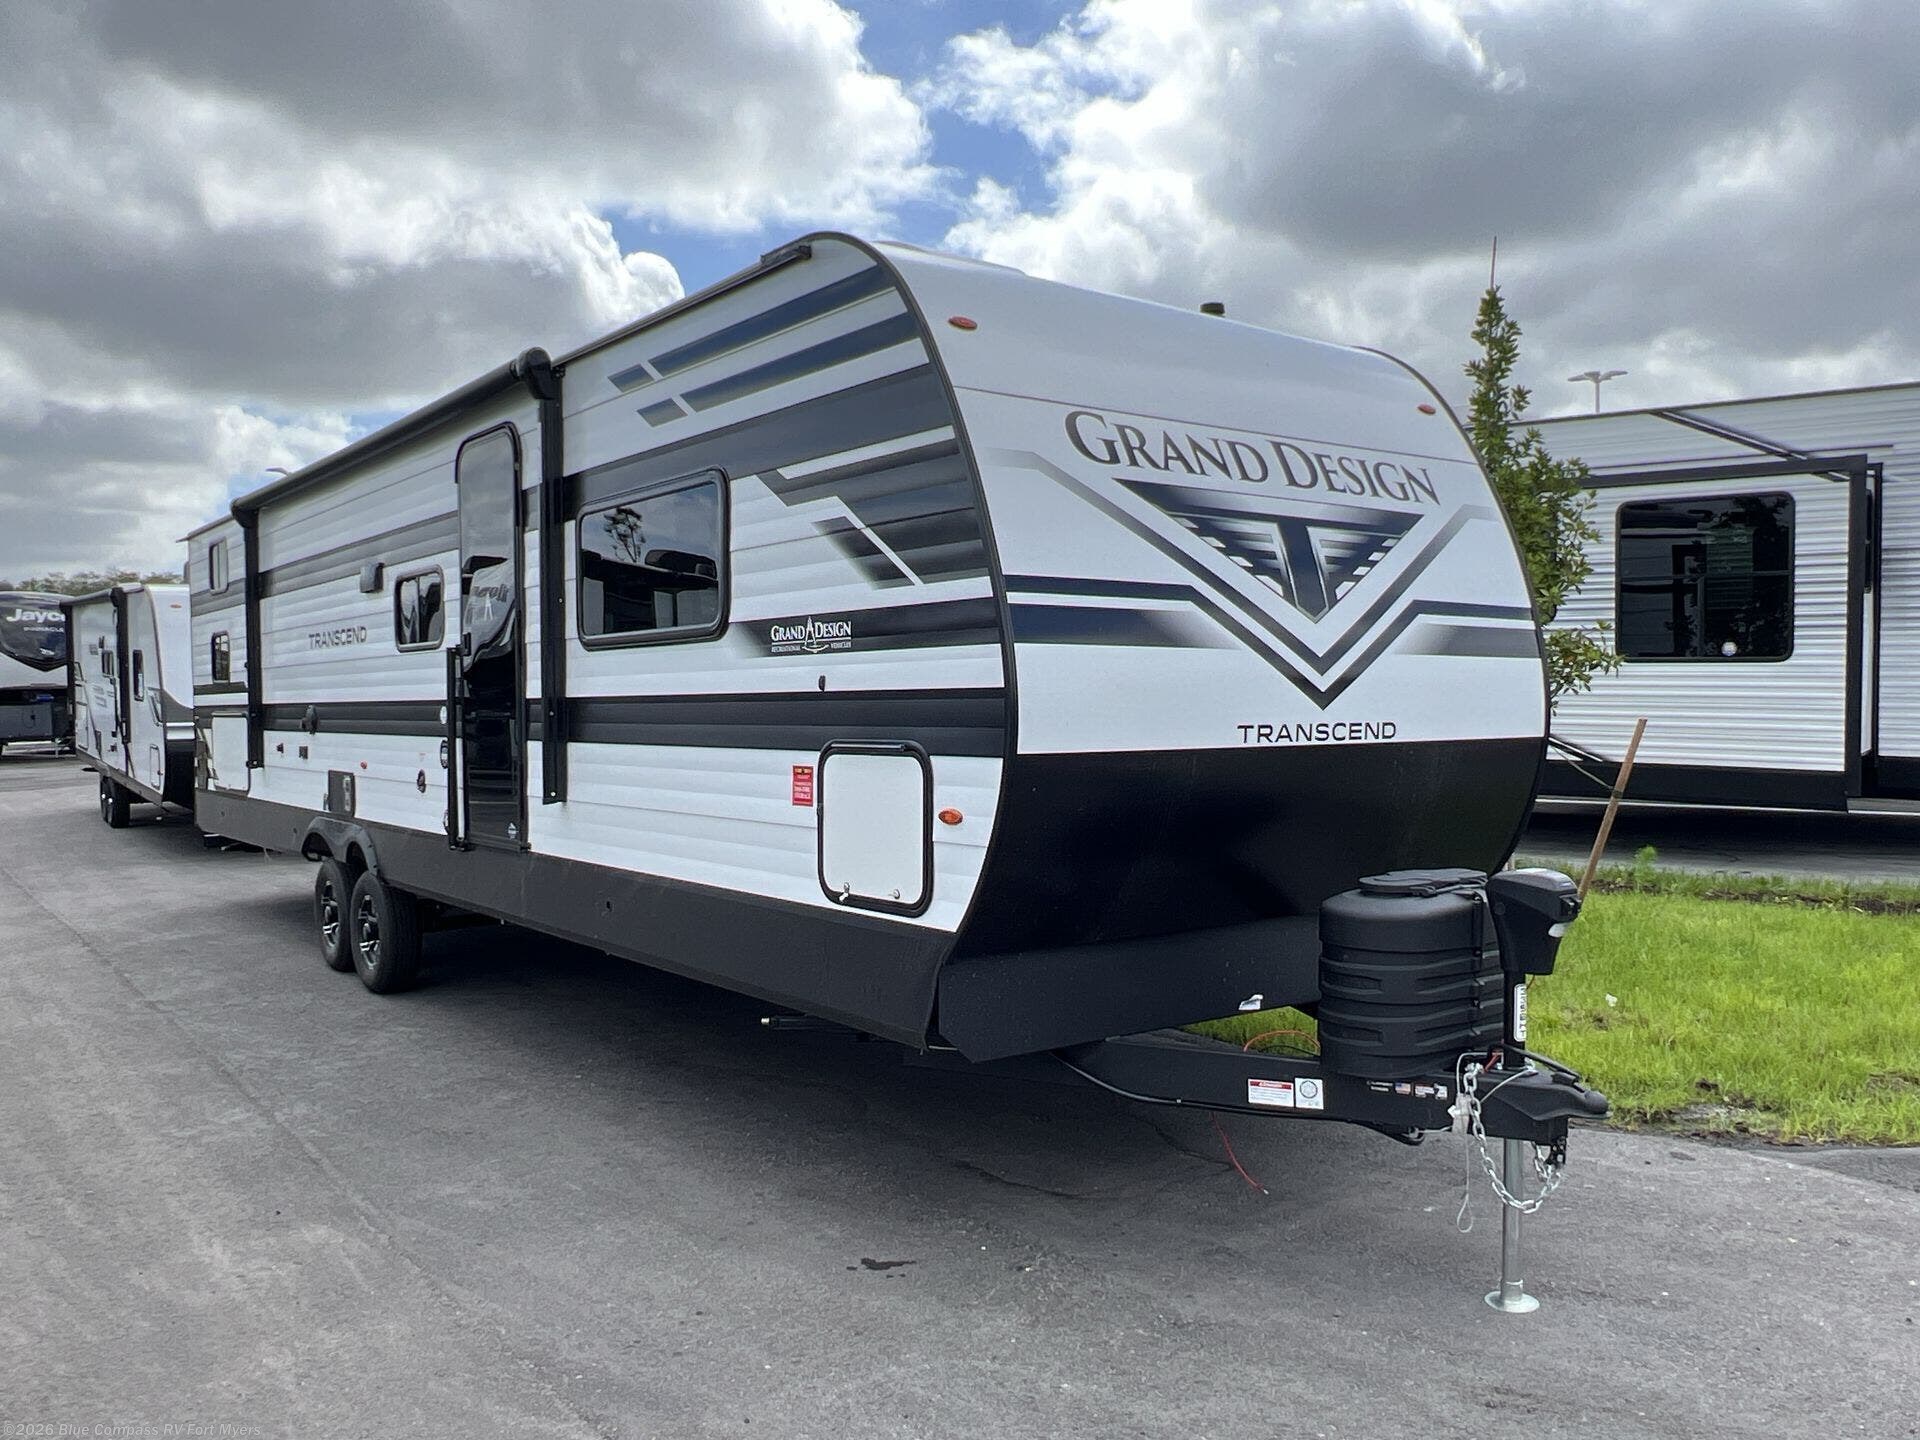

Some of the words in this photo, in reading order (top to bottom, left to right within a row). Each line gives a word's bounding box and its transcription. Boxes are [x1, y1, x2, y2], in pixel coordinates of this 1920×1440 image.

[1065, 410, 1269, 483] GRAND
[1266, 440, 1441, 506] DESIGN
[308, 626, 367, 649] TRANSCEND
[771, 625, 806, 642] GRAND
[814, 621, 852, 638] DESIGN
[1237, 722, 1397, 744] TRANSCEND
